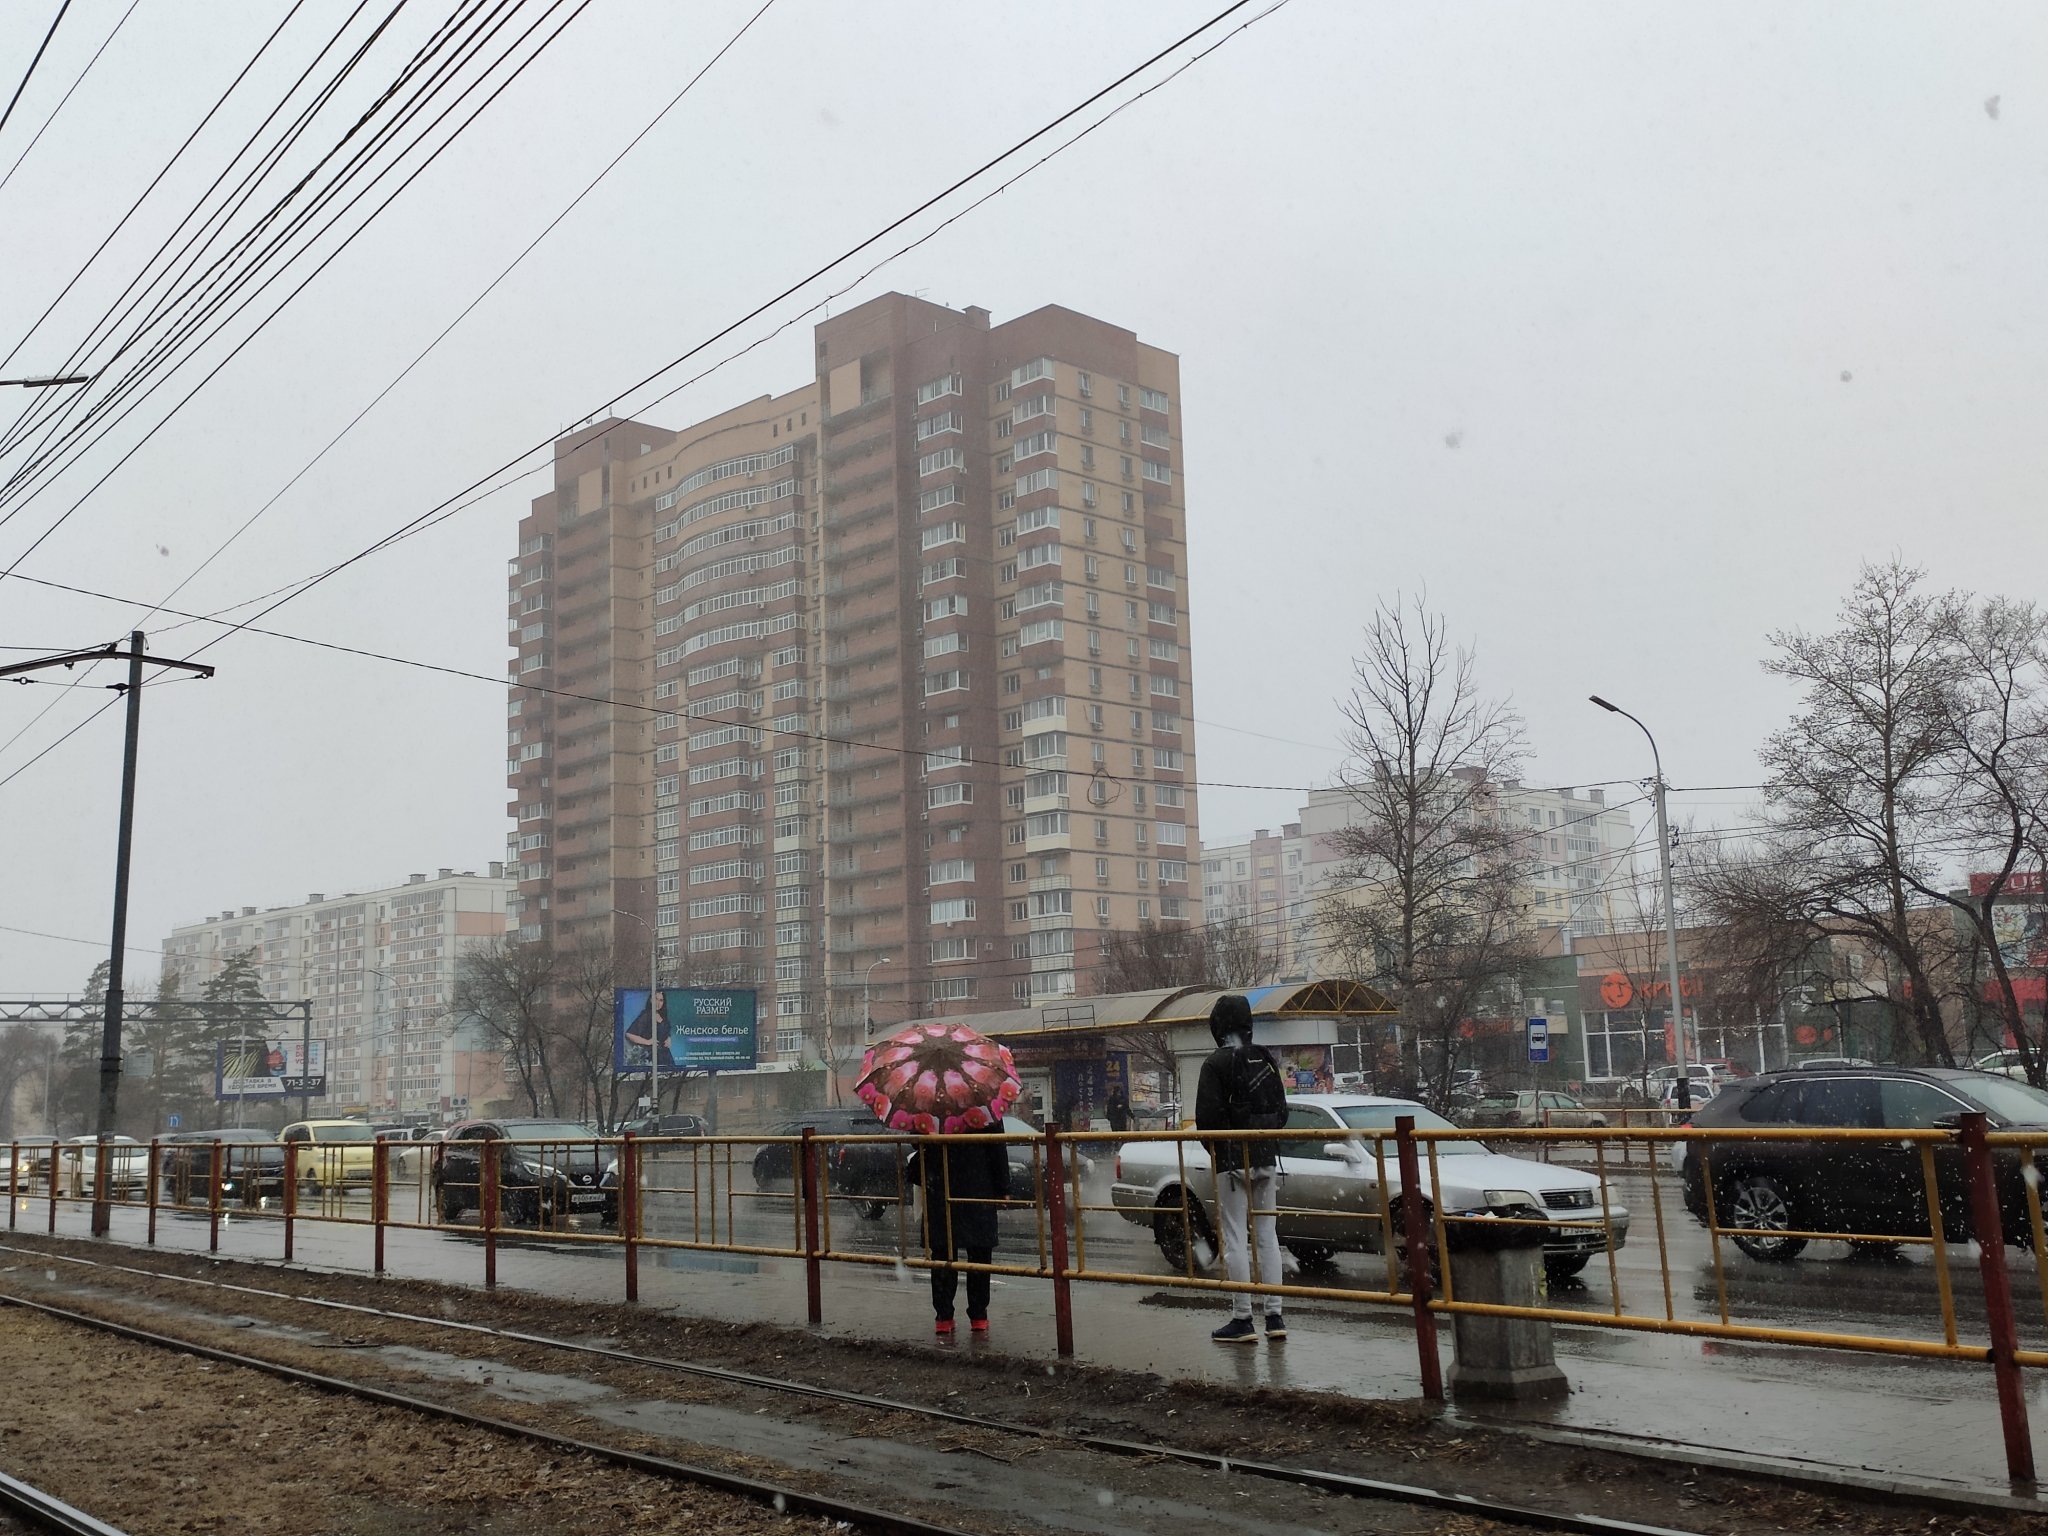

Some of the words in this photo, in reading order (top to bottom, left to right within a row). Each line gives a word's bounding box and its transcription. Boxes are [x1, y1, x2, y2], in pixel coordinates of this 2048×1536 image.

[693, 998, 732, 1007] РУССКИЙ
[676, 1025, 719, 1035] Женское
[721, 1025, 749, 1035] белье
[1105, 1061, 1120, 1071] 24
[286, 1078, 321, 1086] 71-3-37
